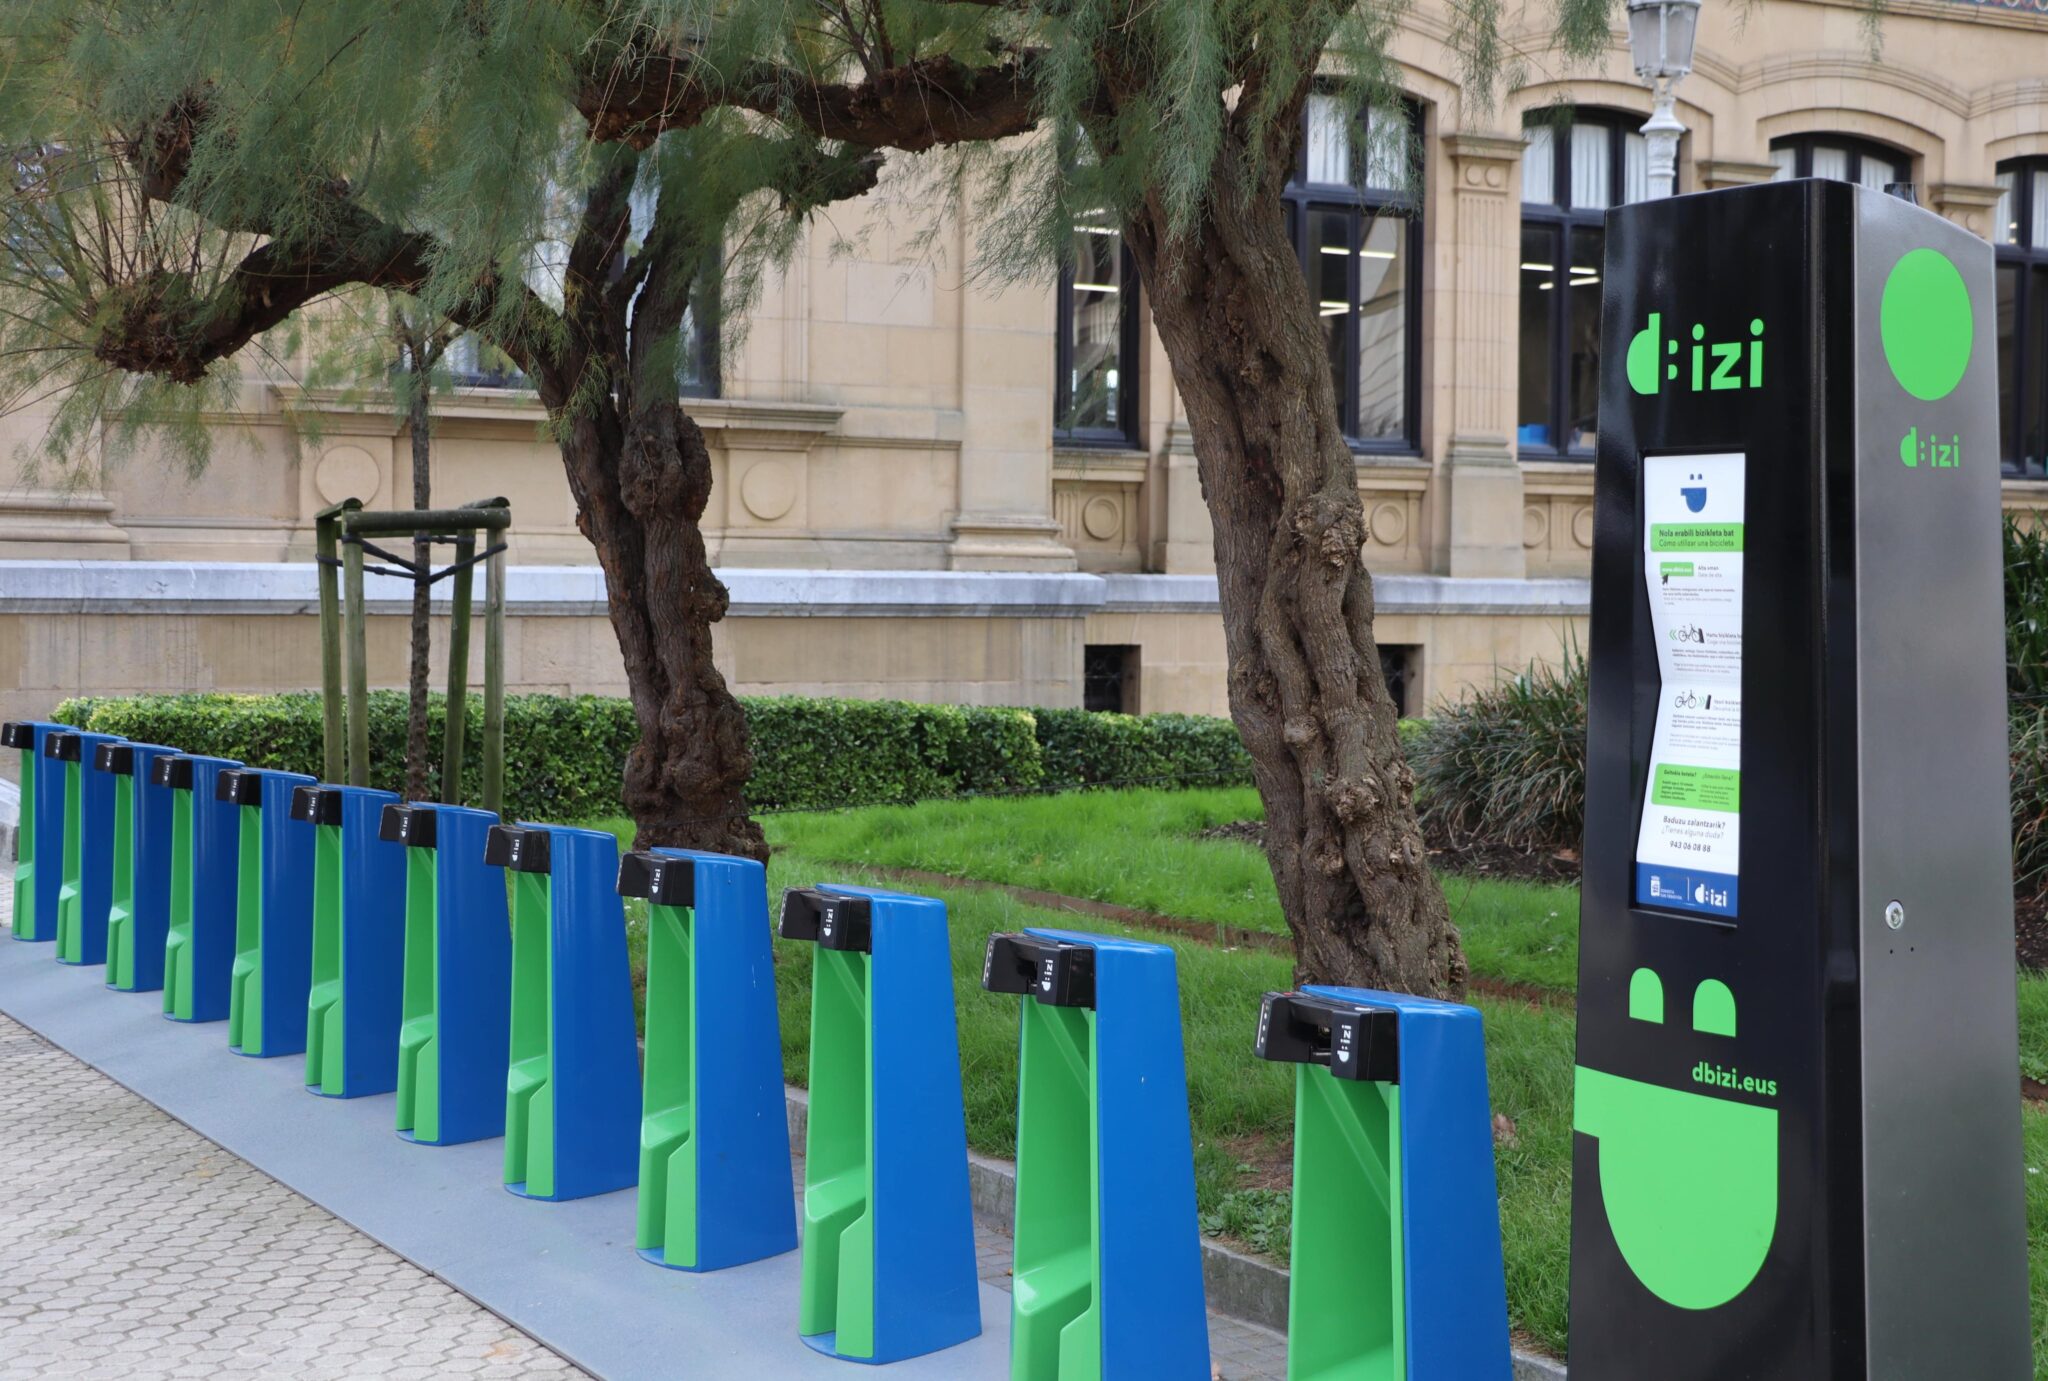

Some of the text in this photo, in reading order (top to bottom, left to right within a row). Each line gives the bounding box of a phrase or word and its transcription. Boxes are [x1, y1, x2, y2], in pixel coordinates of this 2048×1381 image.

[1696, 528, 1722, 536] bizikleta
[1723, 528, 1734, 536] bat
[1710, 538, 1734, 546] bicicleta
[1663, 816, 1726, 828] Baduzu zalantzarik?
[1670, 840, 1711, 852] 943 06 08 88
[1692, 1062, 1778, 1097] dbizi.eus
